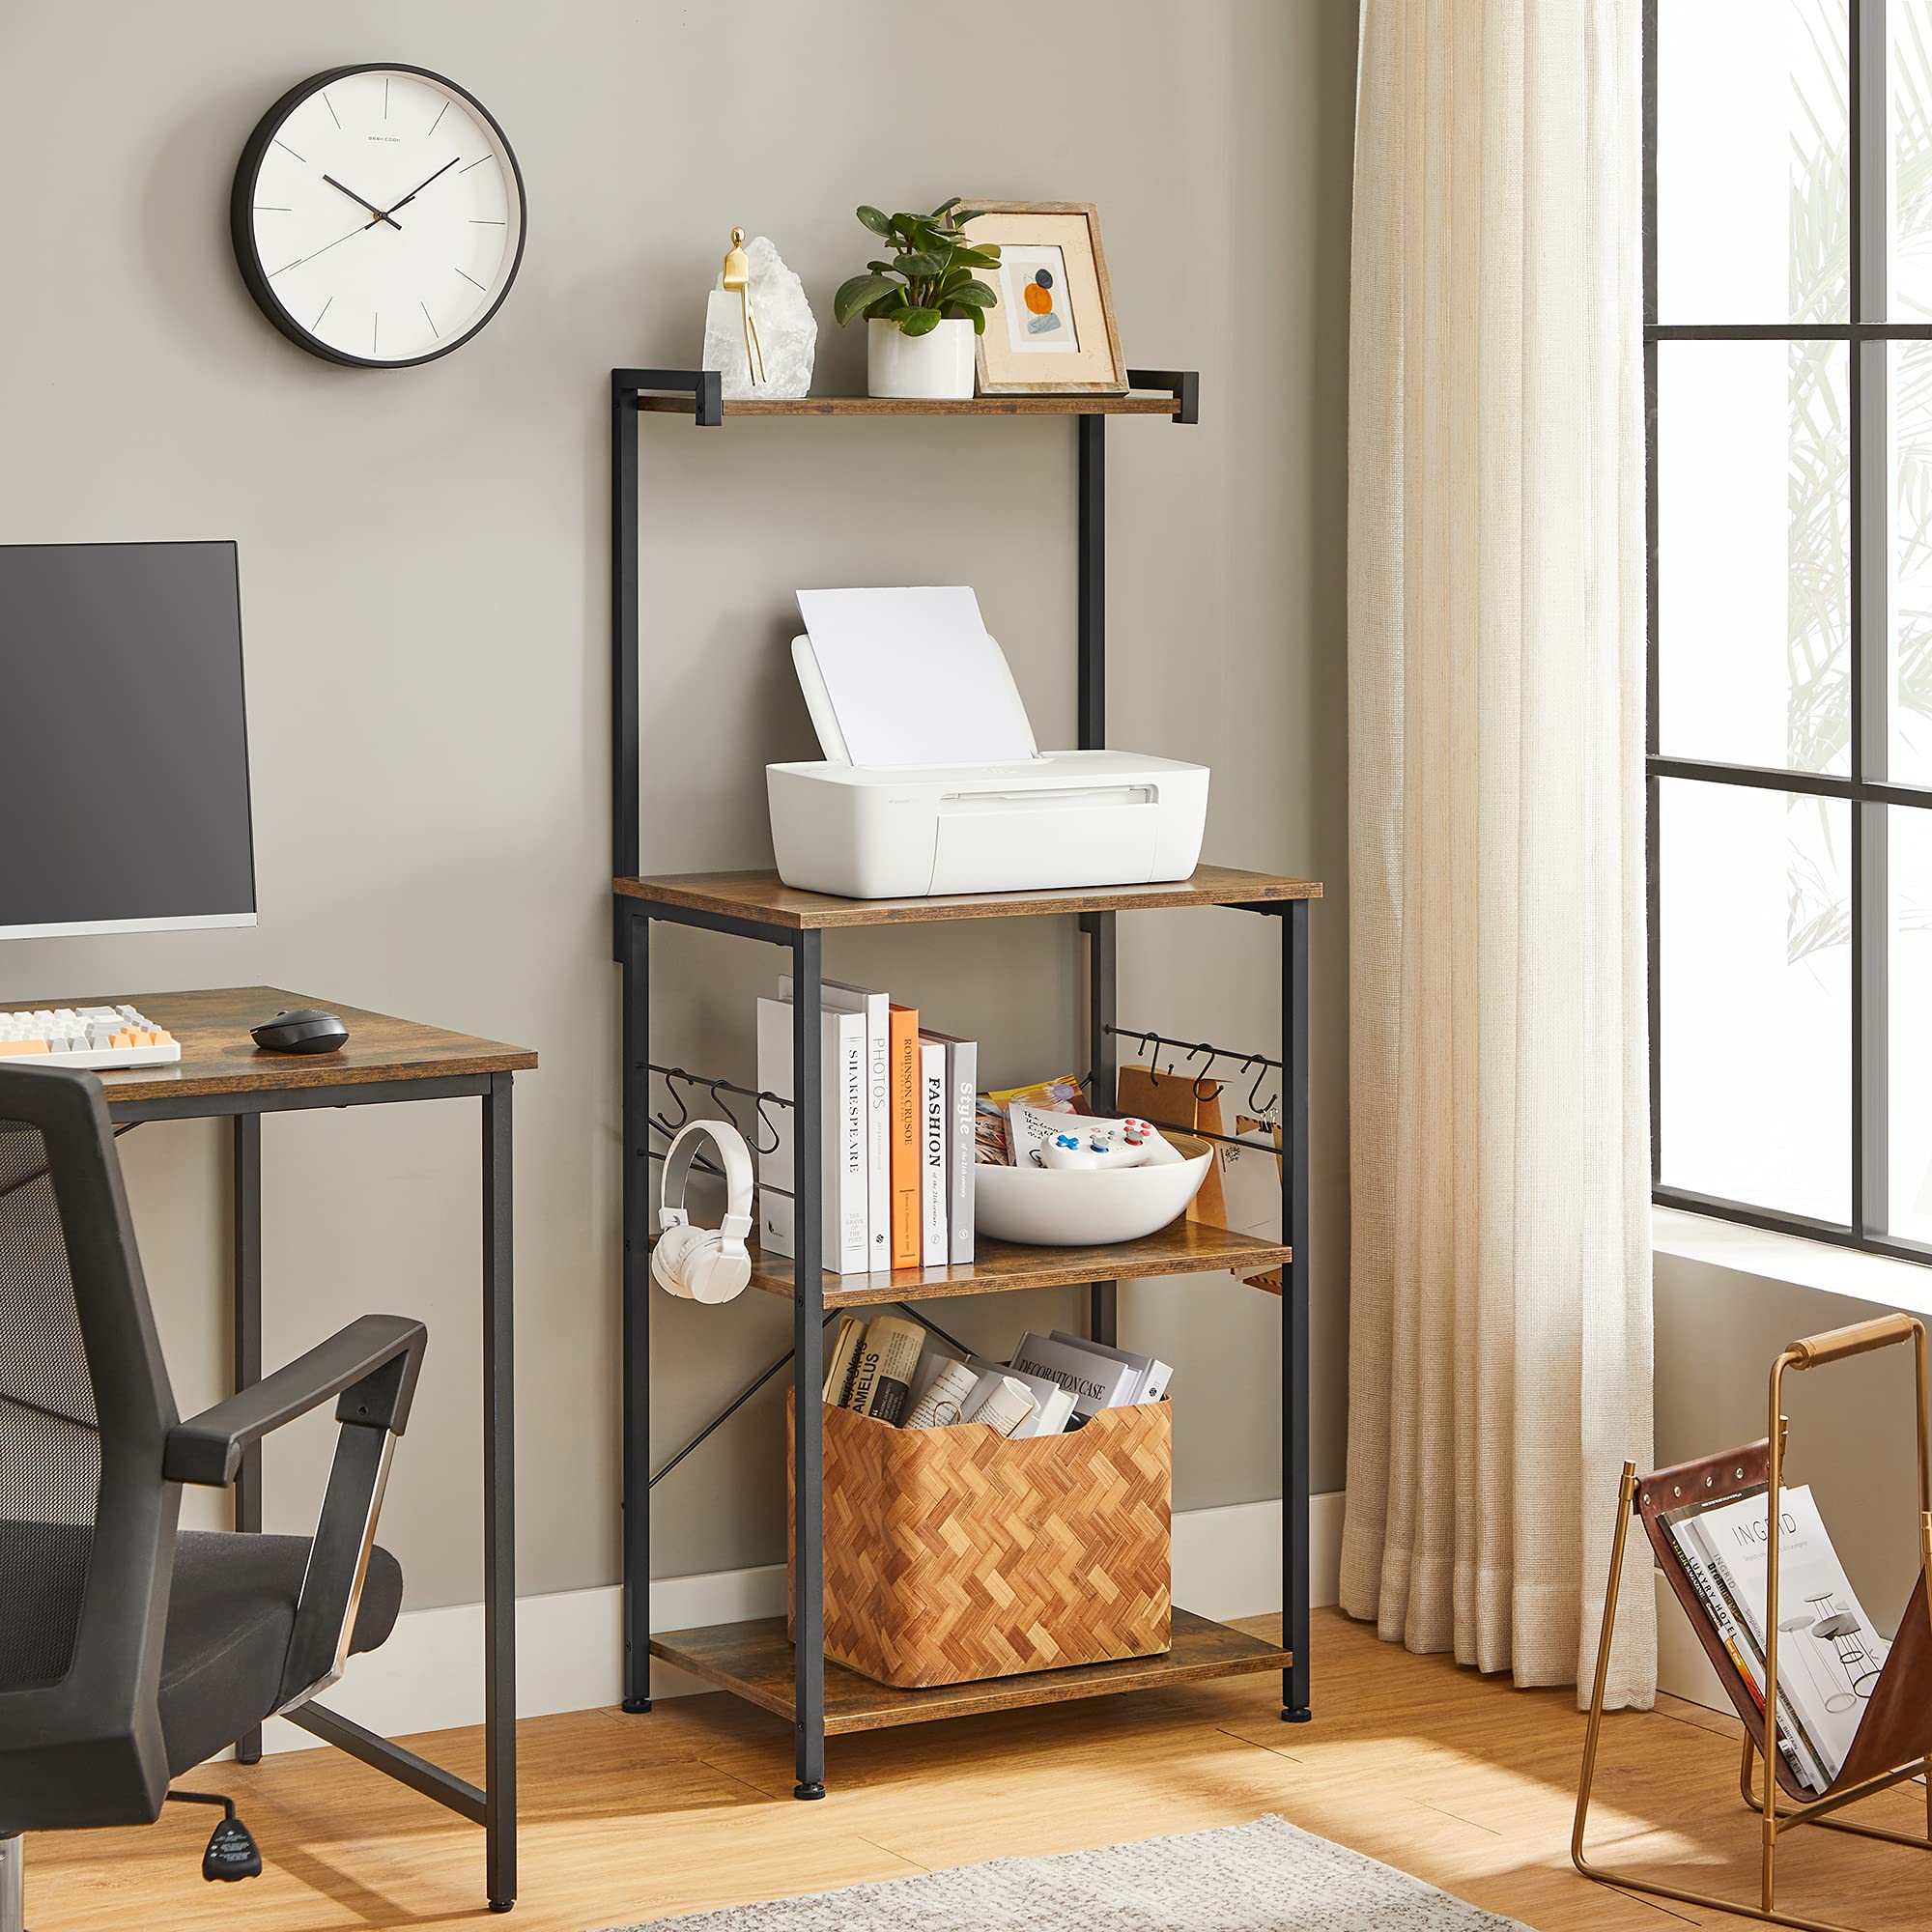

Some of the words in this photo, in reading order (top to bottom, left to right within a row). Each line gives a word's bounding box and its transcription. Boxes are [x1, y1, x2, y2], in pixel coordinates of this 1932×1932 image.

[872, 1037, 886, 1109] PHOTOS
[904, 1038, 913, 1097] ROBINSON
[849, 1049, 859, 1174] SHAKESPEARE
[904, 1099, 913, 1147] CRUSOE
[928, 1077, 941, 1168] FASHION
[957, 1082, 973, 1135] Style
[1019, 1359, 1081, 1391] DECORATION
[1079, 1379, 1106, 1401] CASE
[1689, 1556, 1716, 1599] LUXYRY
[1716, 1604, 1738, 1639] HOTEL
[1714, 1553, 1735, 1589] INGRID
